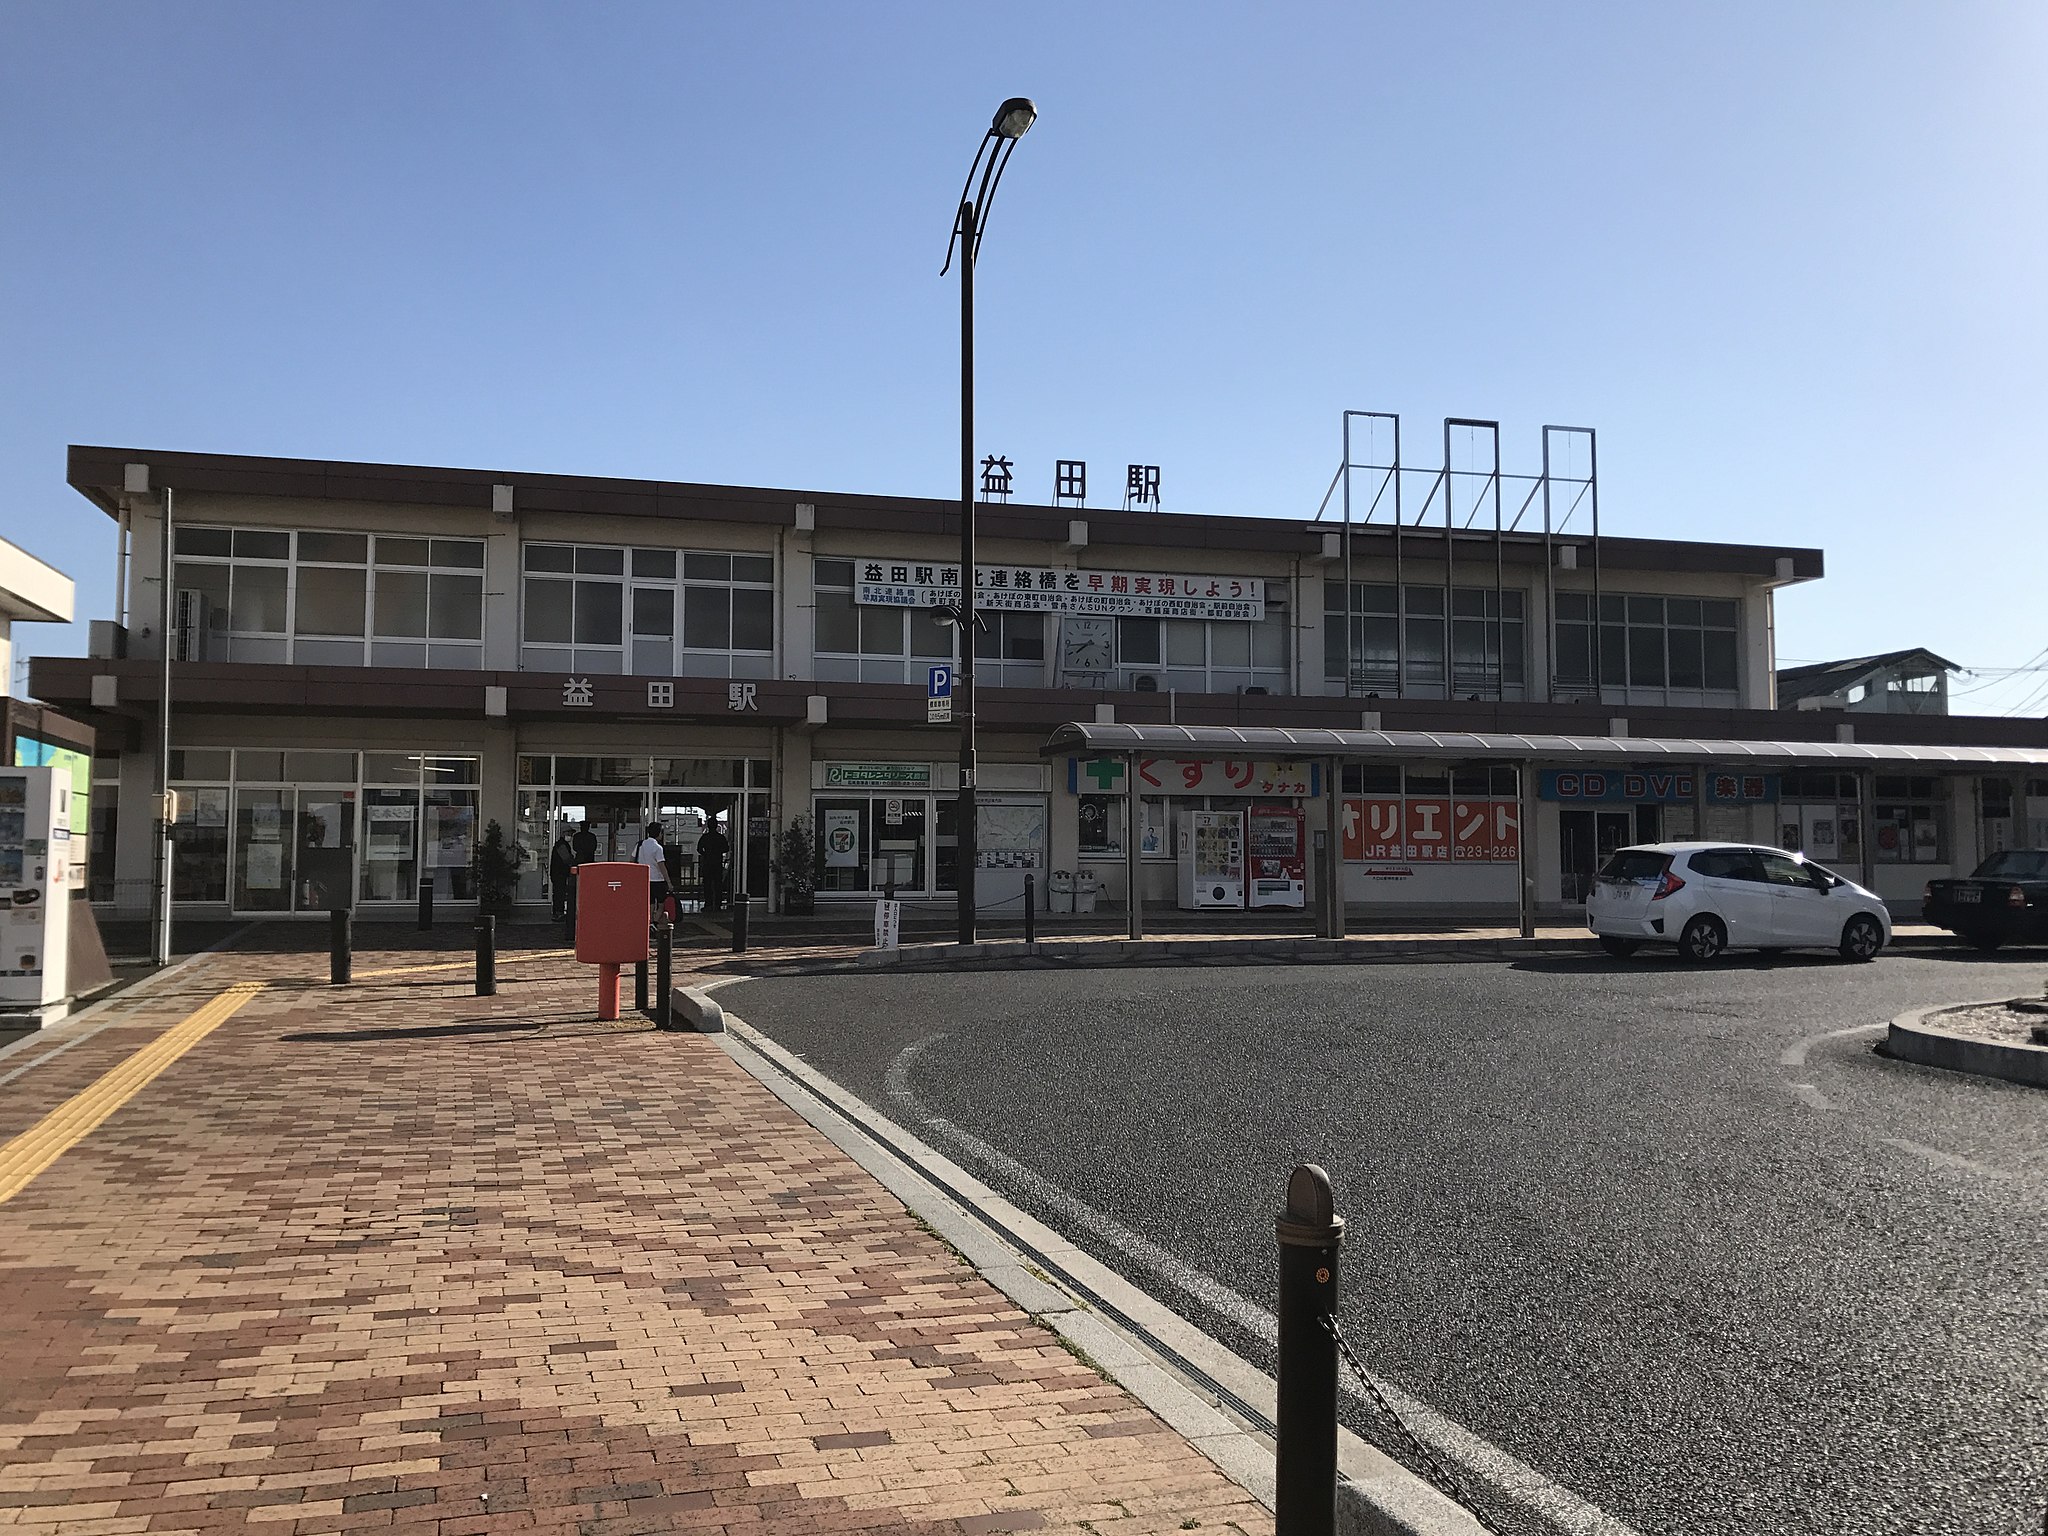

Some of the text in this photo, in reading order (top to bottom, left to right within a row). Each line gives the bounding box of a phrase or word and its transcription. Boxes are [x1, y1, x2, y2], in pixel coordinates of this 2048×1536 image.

[980, 454, 1161, 505] 益田駅
[562, 677, 758, 711] 益田駅
[934, 669, 947, 695] P
[1262, 782, 1306, 794] タナカ
